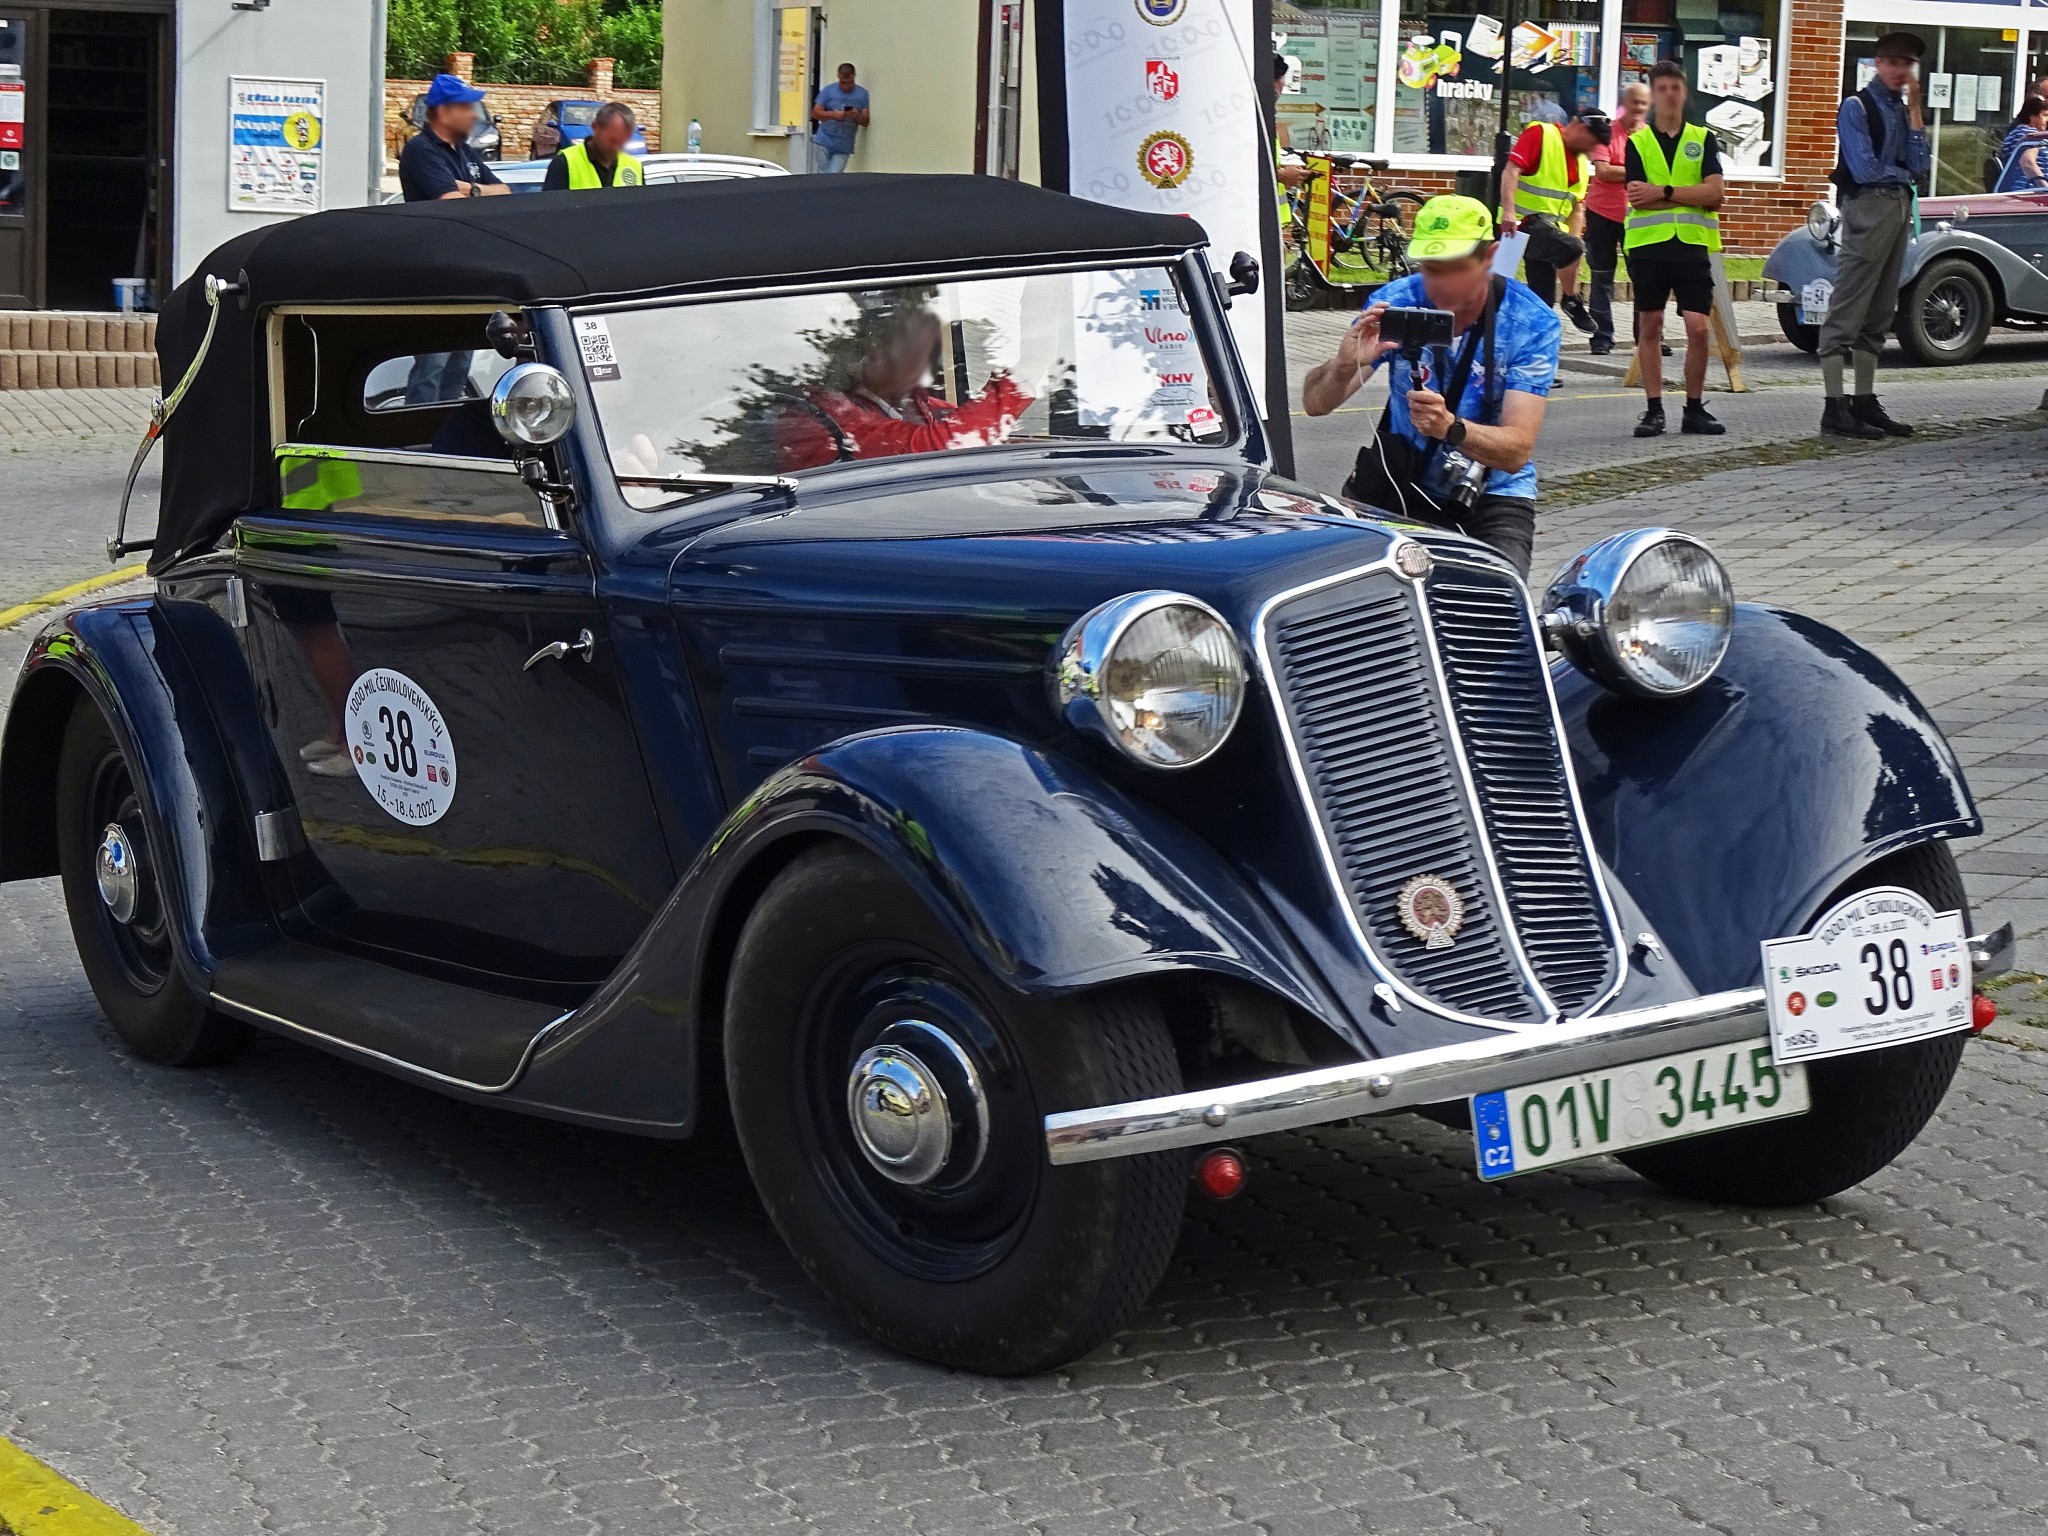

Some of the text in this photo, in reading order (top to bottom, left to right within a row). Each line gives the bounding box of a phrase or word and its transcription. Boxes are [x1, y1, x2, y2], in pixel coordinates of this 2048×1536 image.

[1436, 78, 1494, 101] hračky
[584, 321, 598, 331] 38
[1144, 326, 1189, 344] Vlna
[350, 672, 443, 738] 1000 MIL ČESKOSLOVENSKÝCH
[379, 705, 418, 778] 38
[1795, 963, 1841, 977] ŠKODA
[1859, 938, 1914, 1015] 38
[1520, 1046, 1781, 1157] 01V 3445
[1484, 1146, 1511, 1167] CZ
